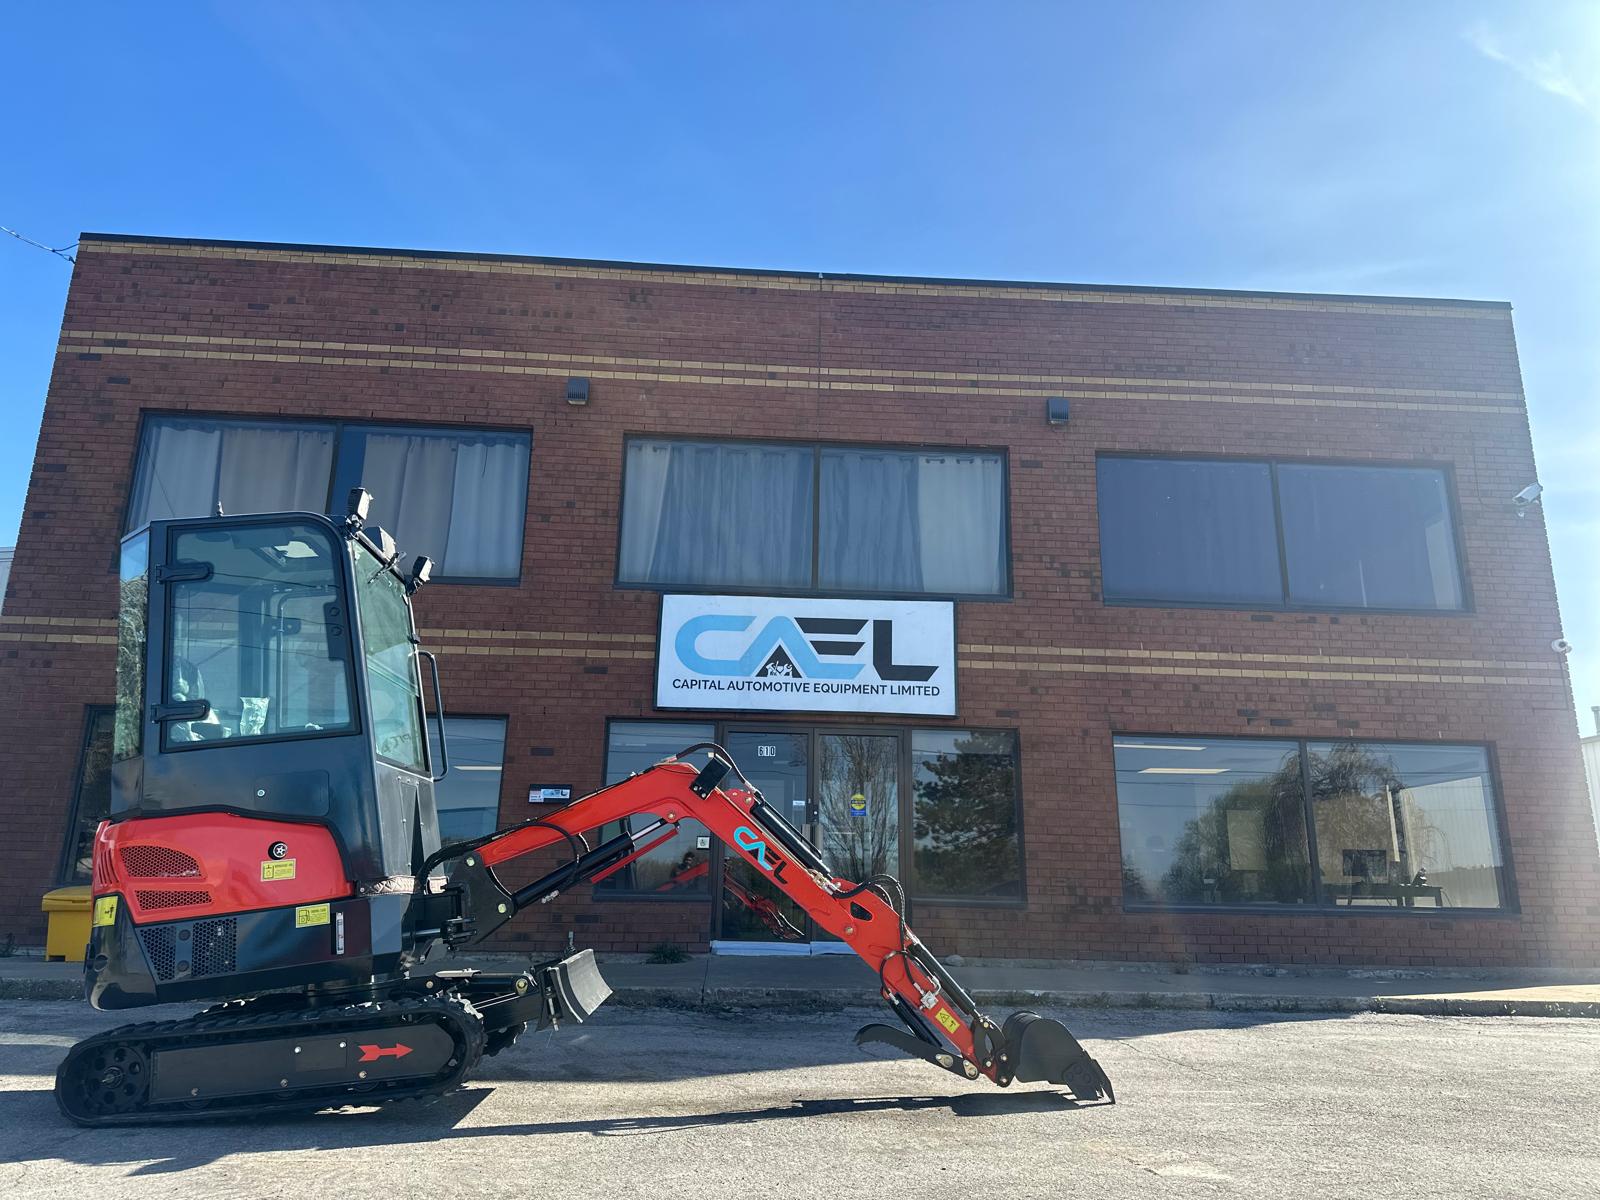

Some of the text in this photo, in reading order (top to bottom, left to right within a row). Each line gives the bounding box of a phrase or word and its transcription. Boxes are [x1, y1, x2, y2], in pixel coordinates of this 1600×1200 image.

[674, 614, 940, 682] CAEL
[672, 678, 940, 697] CAPITAL AUTOMOTIVE EQUIPMENT LIMITED
[758, 745, 776, 757] 610
[733, 826, 788, 885] CAEL
